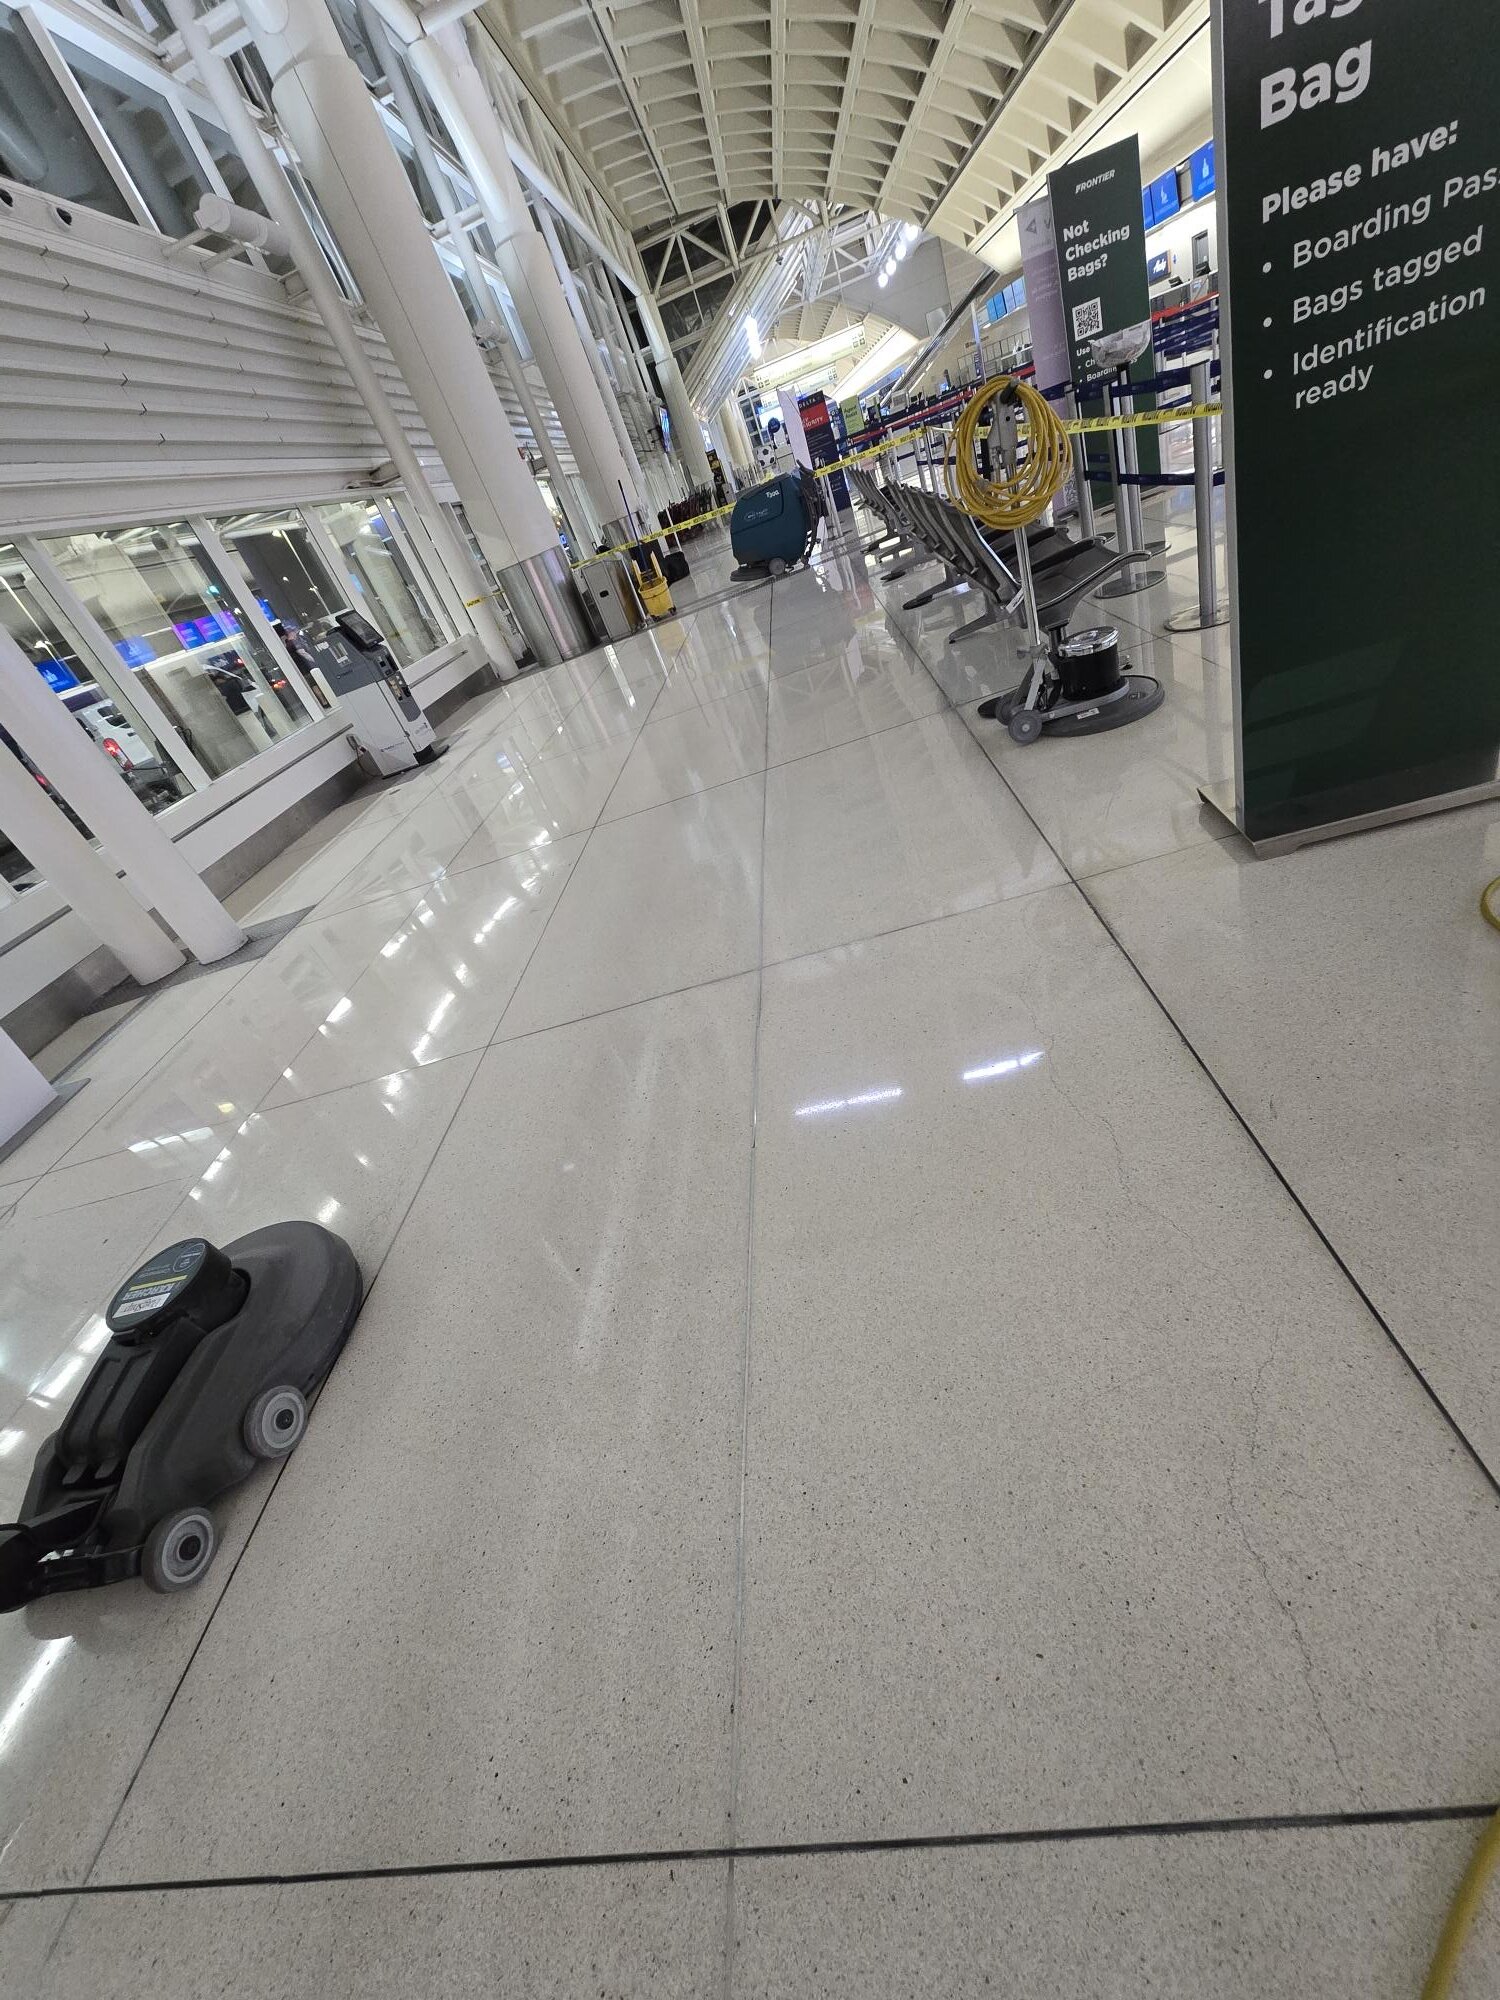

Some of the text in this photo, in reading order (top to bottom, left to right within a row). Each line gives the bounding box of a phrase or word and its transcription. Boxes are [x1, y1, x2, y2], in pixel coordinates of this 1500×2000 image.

[1260, 38, 1372, 130] Bag
[1074, 168, 1116, 195] FRONTIER
[1262, 120, 1459, 224] Please have:
[1063, 219, 1090, 242] Not
[1292, 167, 1500, 270] Boarding Pas
[1065, 224, 1130, 261] Checking
[1067, 253, 1108, 282] Bags?
[1292, 226, 1484, 324] Bags tagged
[1076, 346, 1091, 357] Use
[1292, 284, 1486, 376] Identification
[798, 398, 817, 409] DELTA
[1294, 362, 1375, 411] ready
